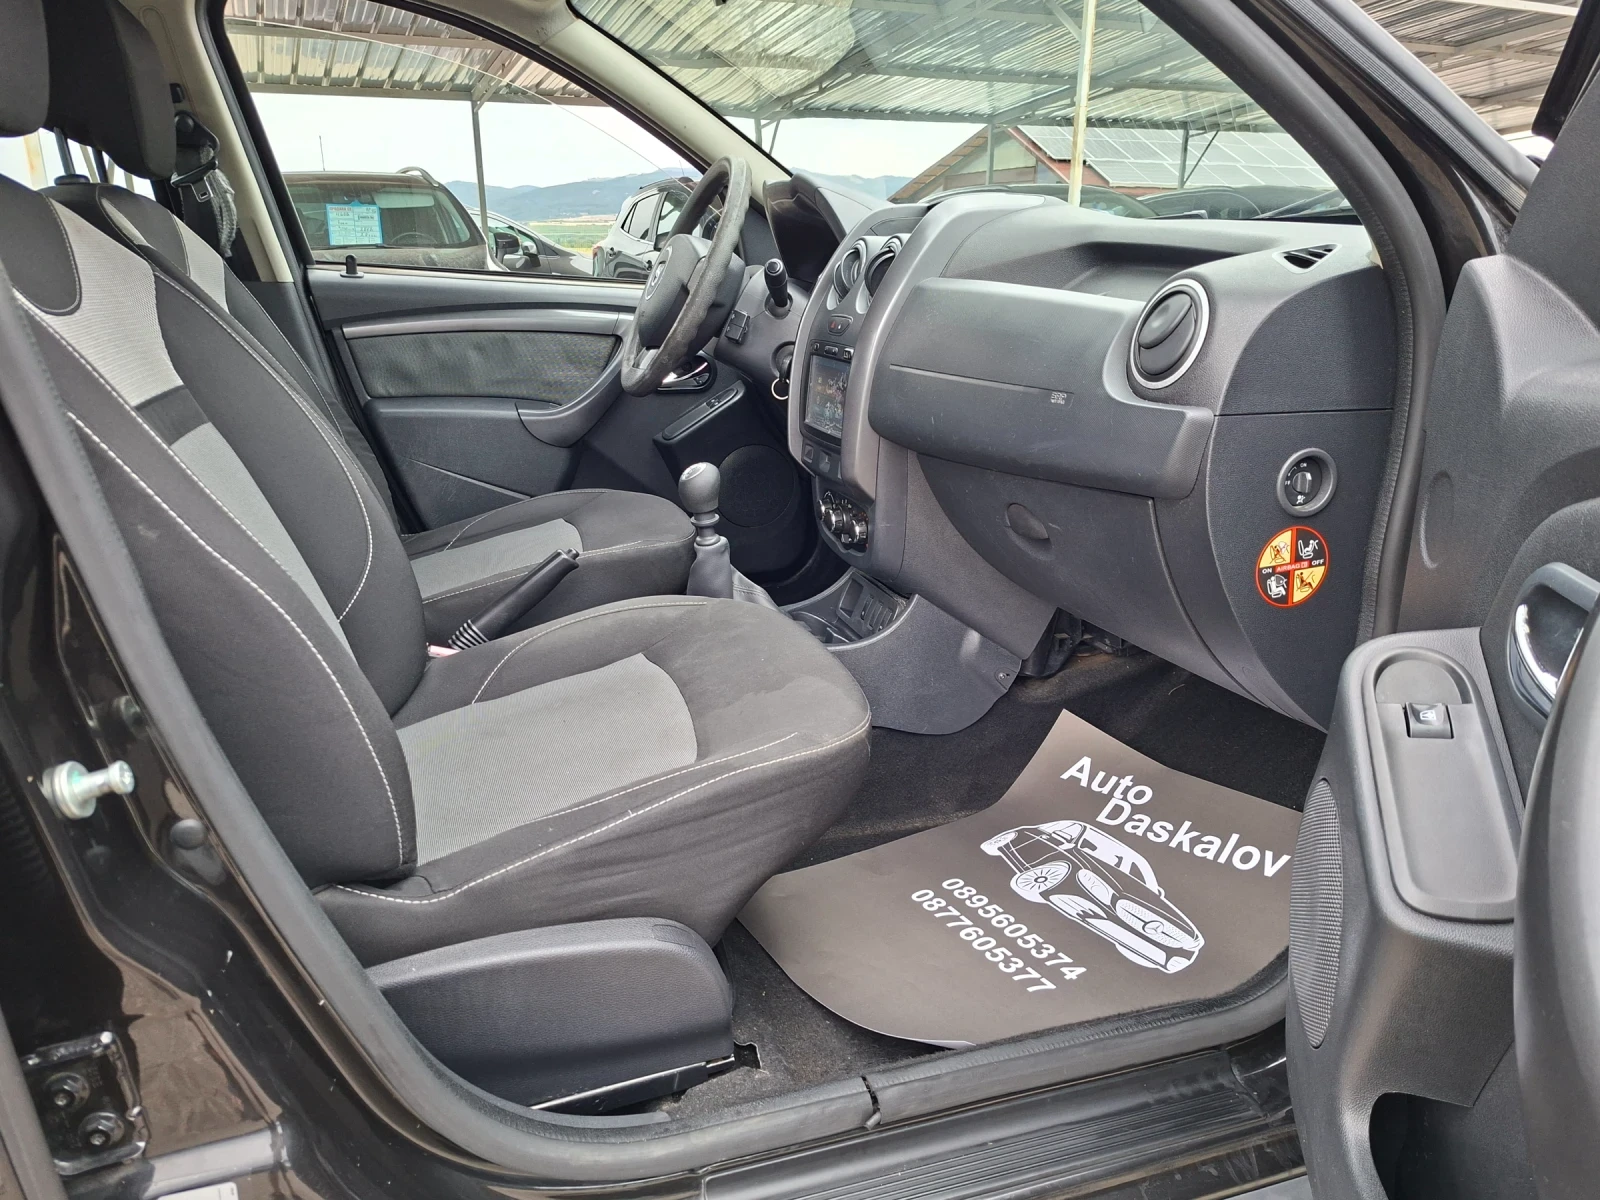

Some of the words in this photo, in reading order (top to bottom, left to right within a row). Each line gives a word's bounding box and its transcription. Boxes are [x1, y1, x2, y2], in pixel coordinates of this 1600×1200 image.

[1276, 563, 1301, 573] AIRBAG
[1311, 558, 1325, 566] OFF
[1059, 755, 1154, 806] Auto
[1095, 796, 1292, 878] Daskalov
[911, 888, 1057, 993] 0877605377
[941, 877, 1088, 981] 0895605374
